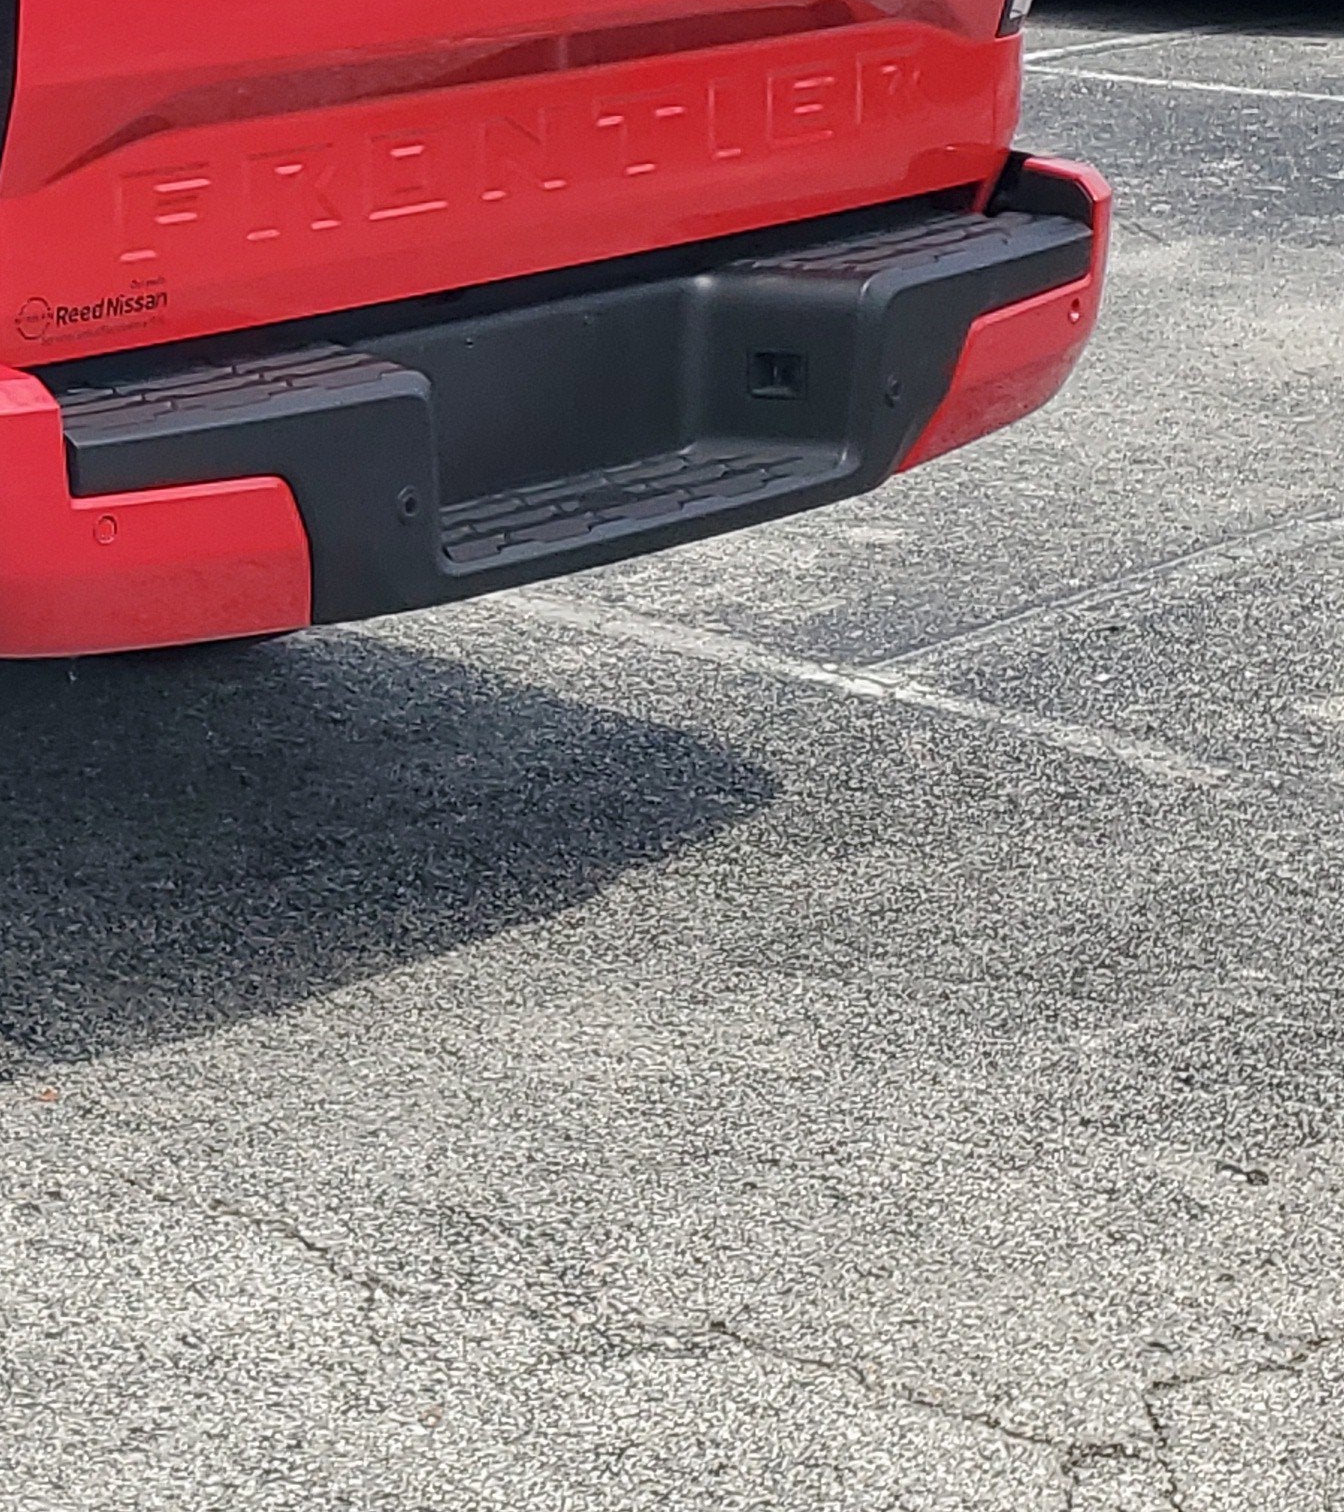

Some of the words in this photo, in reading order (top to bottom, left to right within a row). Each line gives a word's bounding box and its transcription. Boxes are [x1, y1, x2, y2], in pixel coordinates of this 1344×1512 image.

[118, 41, 922, 262] FRONTIER
[56, 298, 104, 326] Reed
[106, 291, 168, 317] Nissan
